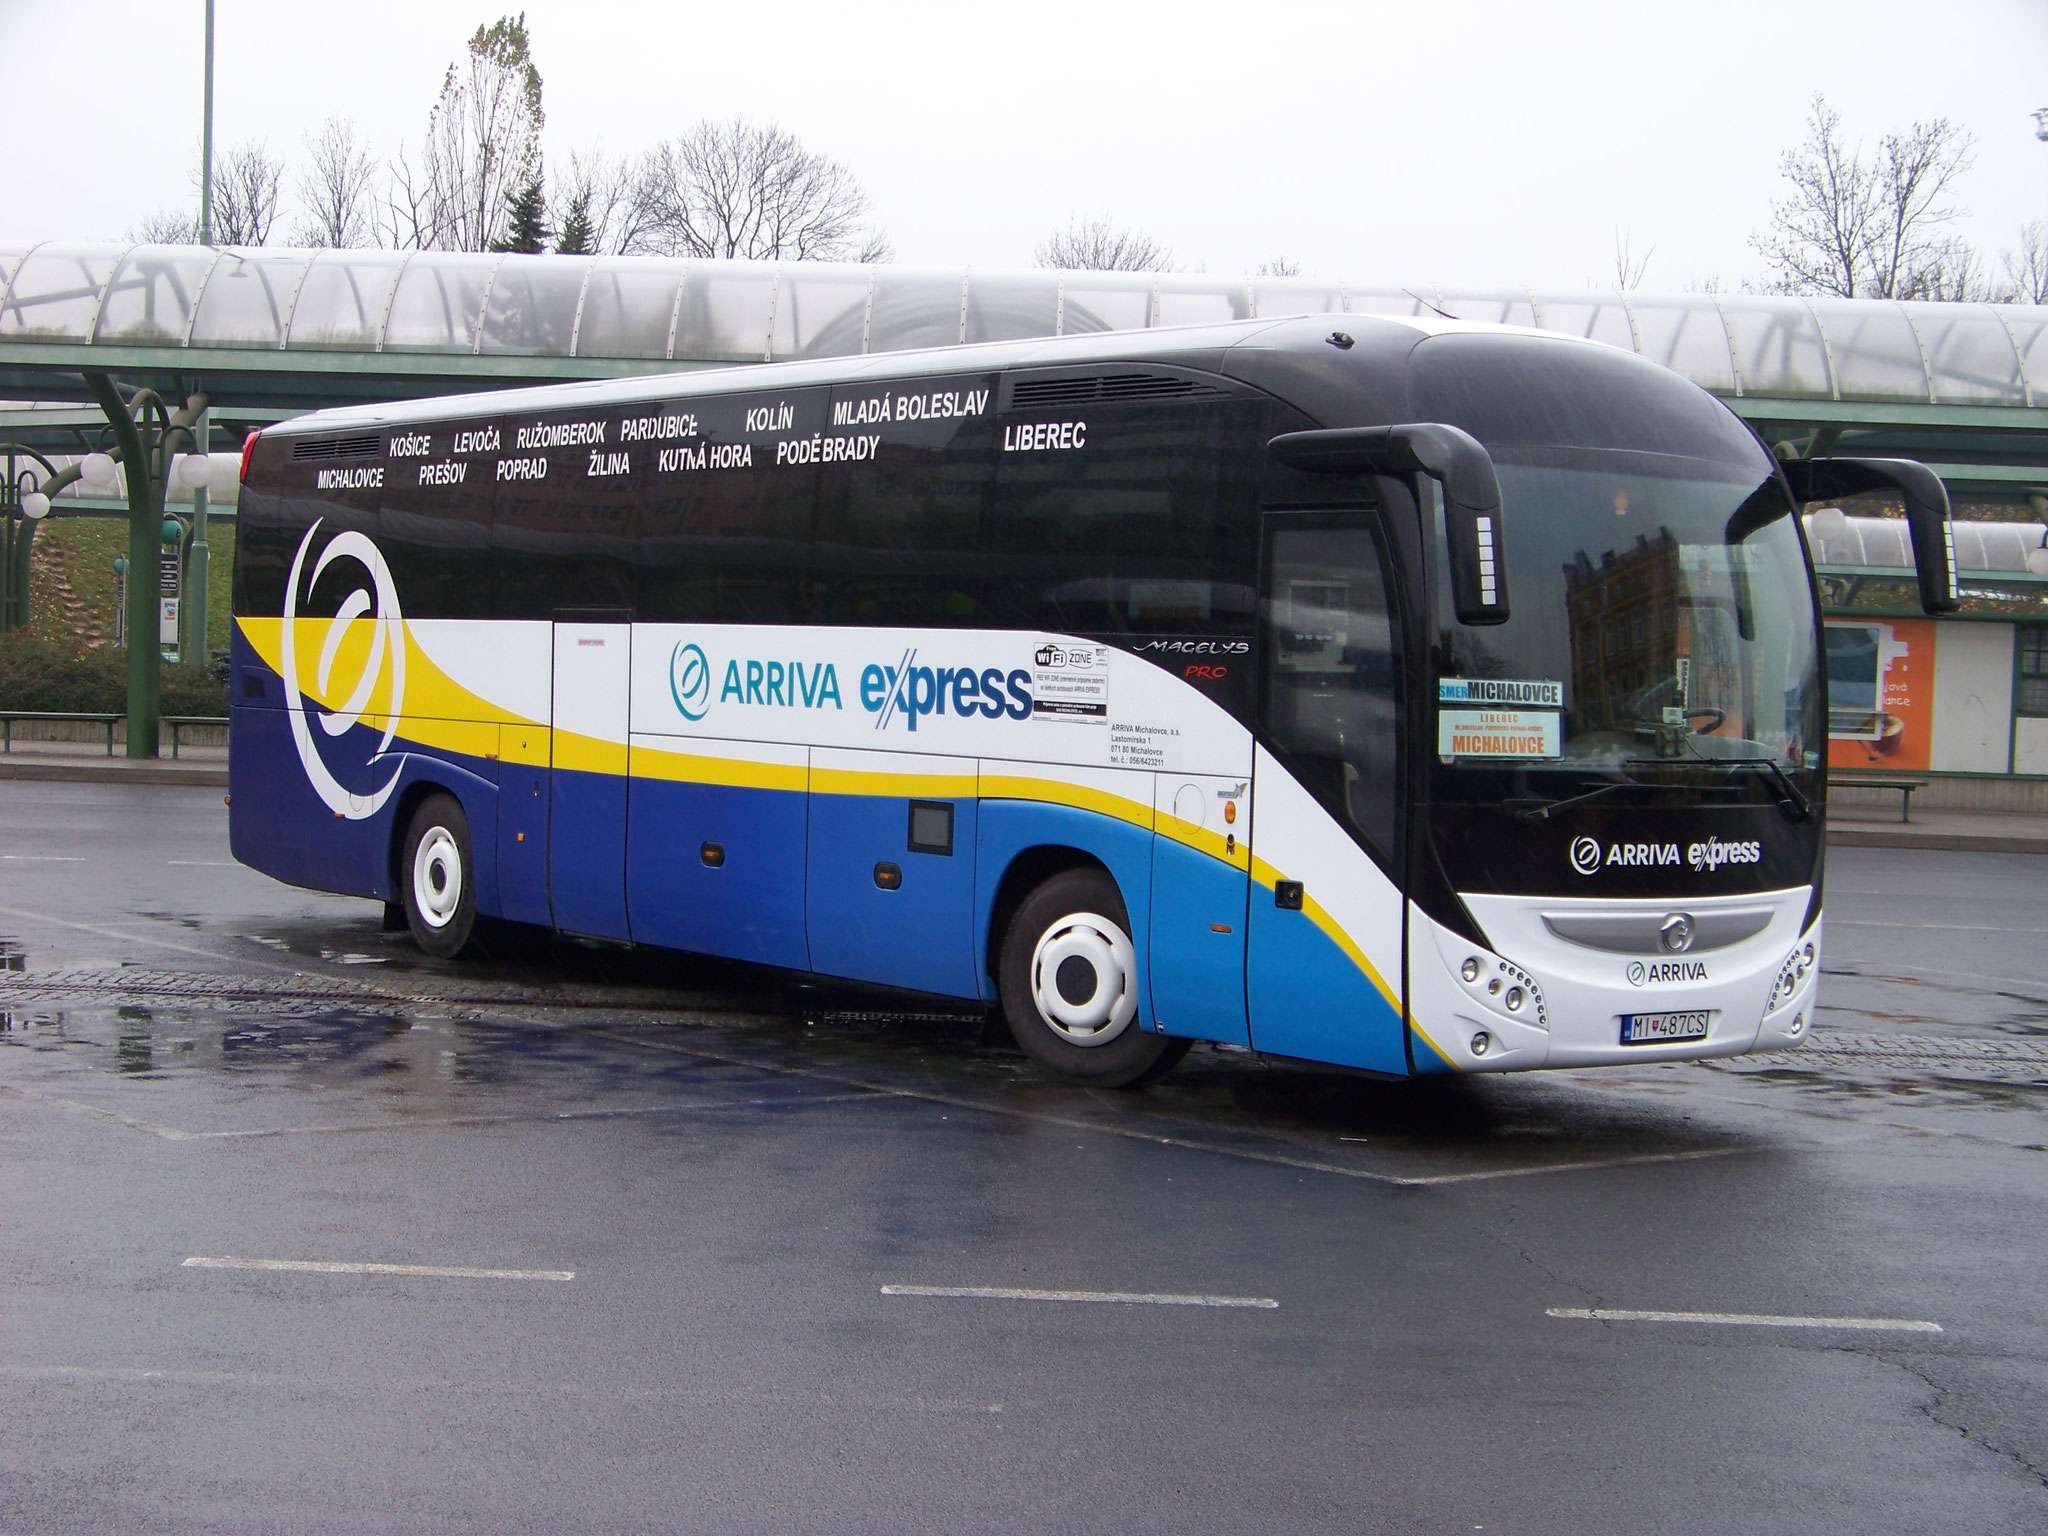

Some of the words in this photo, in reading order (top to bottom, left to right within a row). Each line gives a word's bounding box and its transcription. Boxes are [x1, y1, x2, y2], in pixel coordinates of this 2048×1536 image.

[389, 433, 431, 458] KOŠICE
[453, 425, 500, 454] LEVOČA
[516, 419, 607, 450] RUŽOMBEROK
[620, 414, 698, 442] PARDUBICE
[746, 401, 794, 433] KOLÍN
[833, 392, 891, 426] MLADÁ
[896, 389, 989, 422] BOLESLAV
[317, 467, 384, 490] MICHALOVCE
[419, 460, 467, 486] PREŠOV
[496, 457, 548, 482] POPRAD
[588, 449, 630, 477] ŽILINA
[658, 441, 706, 473] KUTNÁ
[709, 443, 752, 469] HORA
[776, 433, 880, 466] PODĚBRADY
[1004, 421, 1087, 452] LIBEREC
[1133, 641, 1250, 655] MAGELYS
[1069, 653, 1092, 664] ZONE
[1185, 665, 1228, 679] PRO
[720, 659, 843, 710] ARRIVA
[860, 648, 1033, 732] express
[1440, 685, 1468, 699] SMER
[1468, 681, 1558, 703] MICHALOVCE
[1111, 724, 1134, 732] ARRIVA
[1480, 713, 1519, 723] LIBEREC
[1130, 747, 1163, 756] Michalovce
[1452, 735, 1545, 754] MICHALOVCE
[1606, 843, 1681, 866] ARRIVA
[1687, 836, 1761, 871] express
[1648, 962, 1709, 983] ARRIVA
[1633, 1016, 1649, 1037] MI
[1660, 1013, 1705, 1036] 487CS
